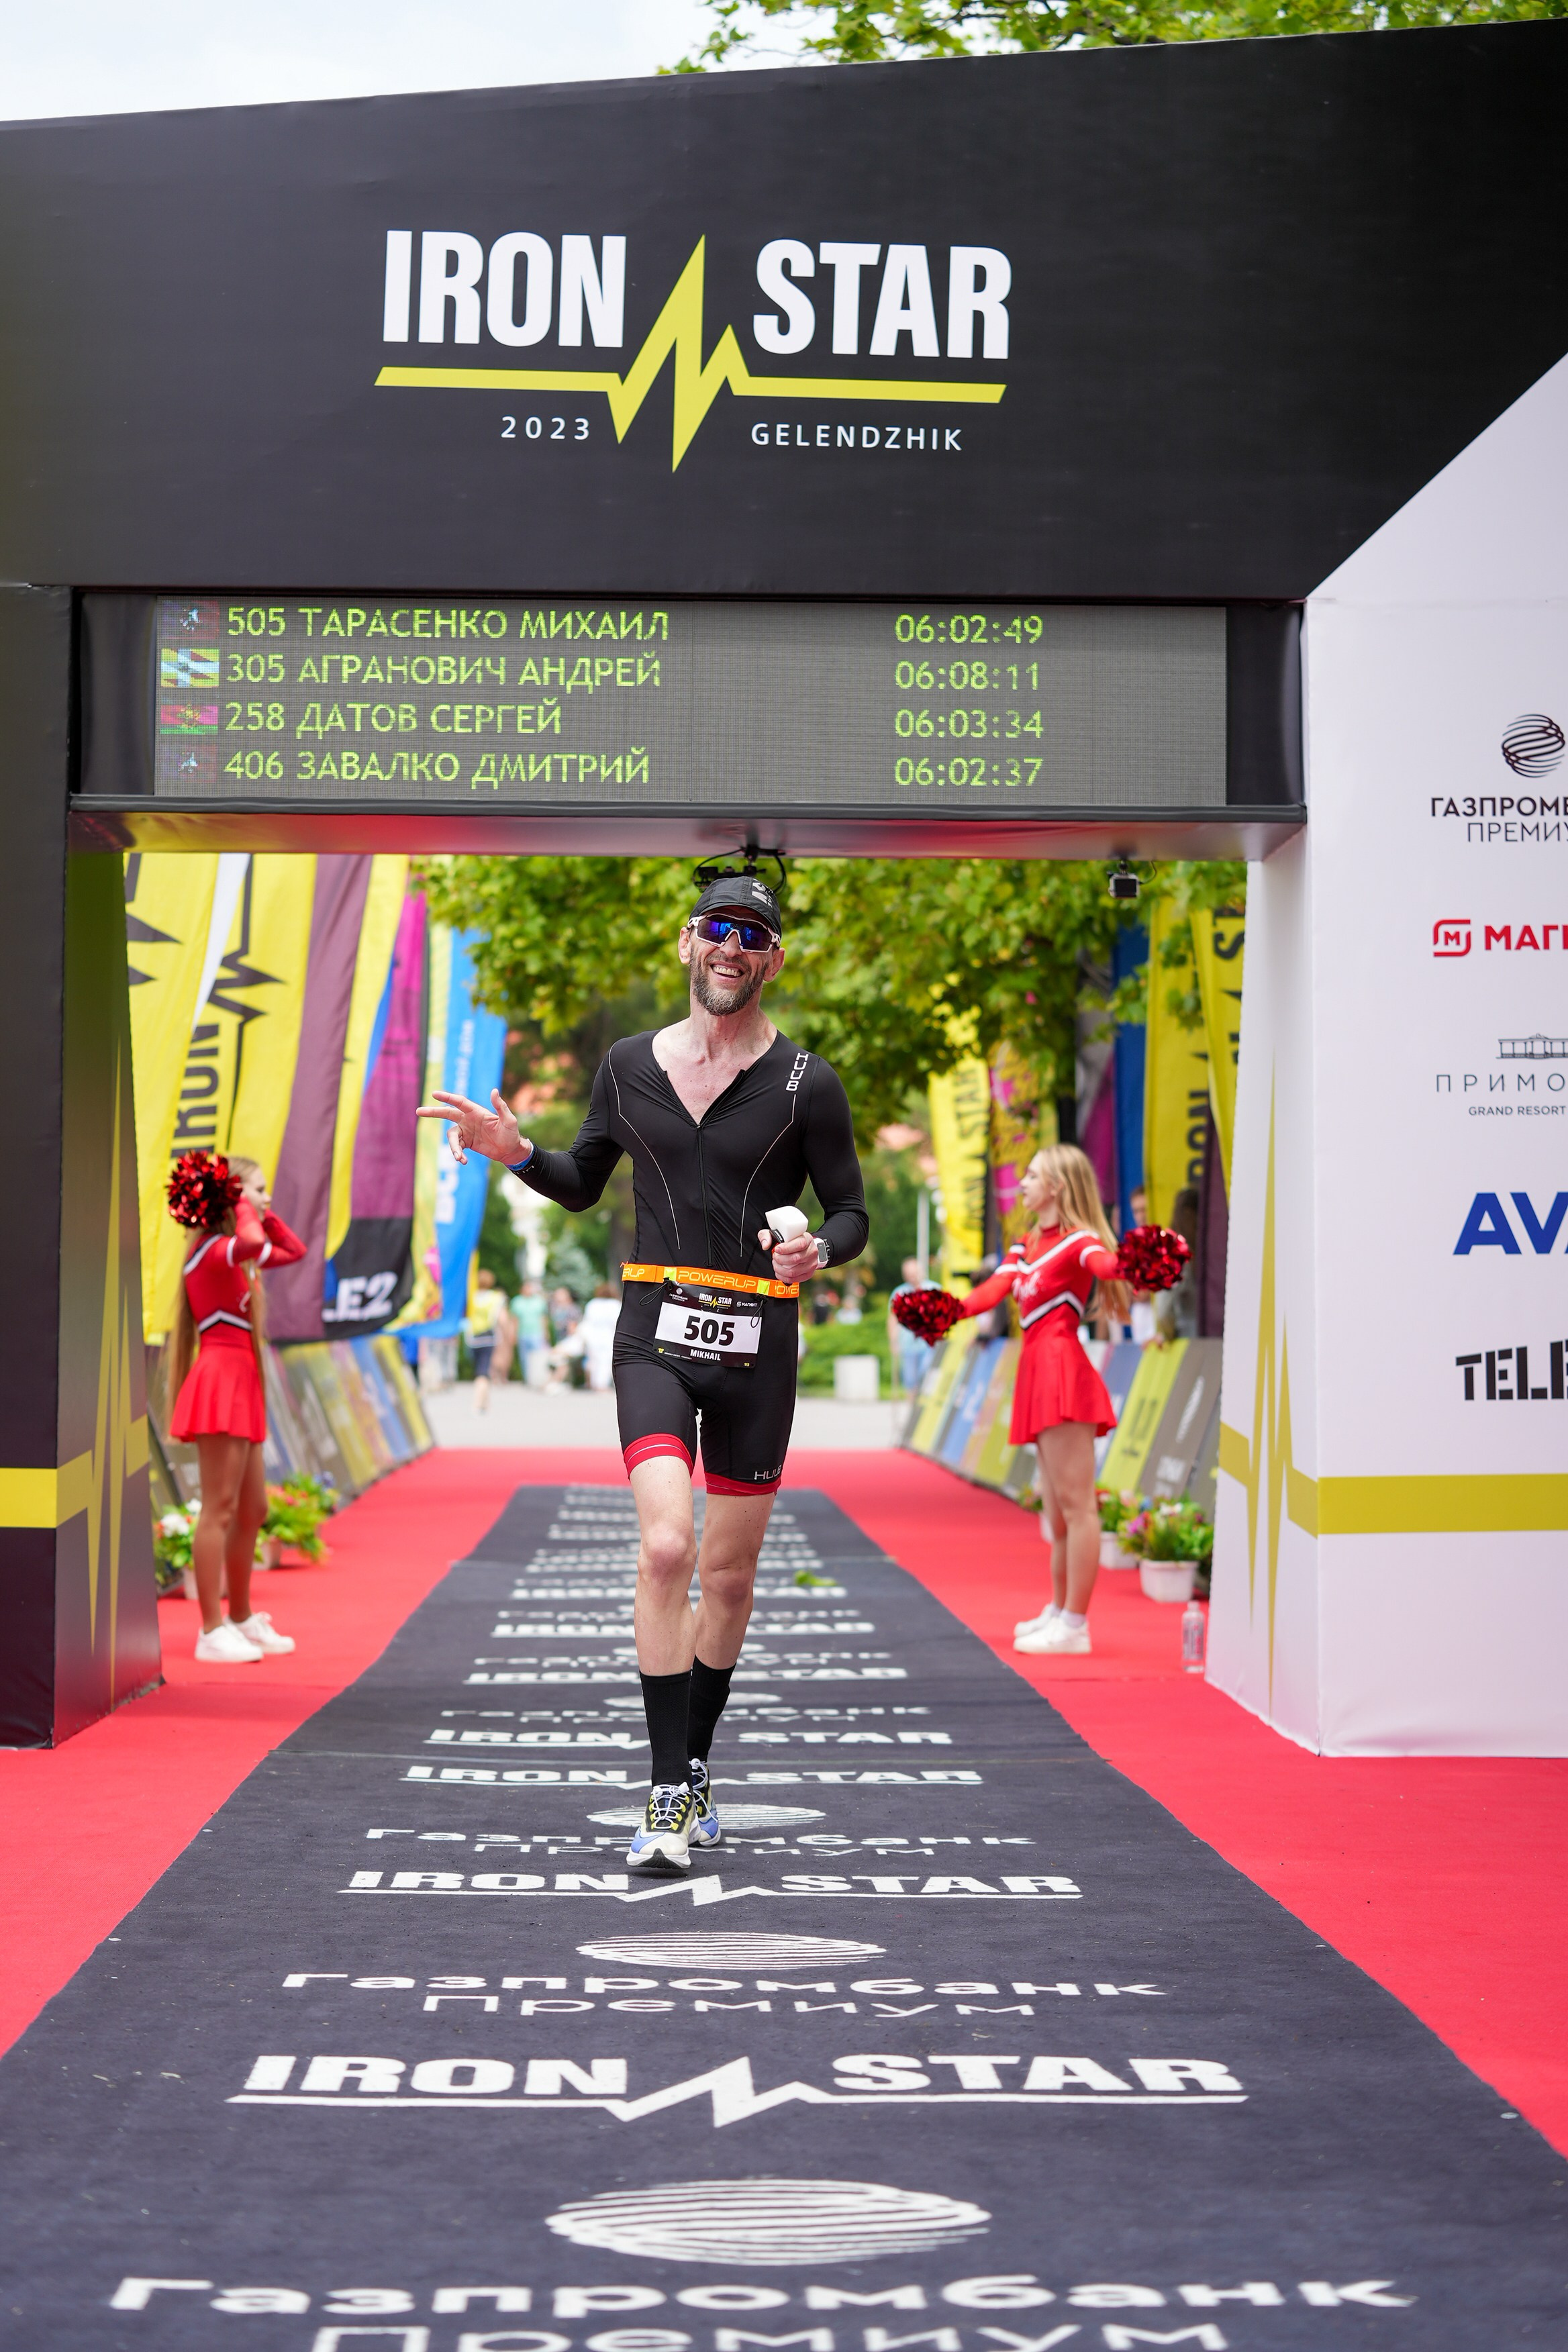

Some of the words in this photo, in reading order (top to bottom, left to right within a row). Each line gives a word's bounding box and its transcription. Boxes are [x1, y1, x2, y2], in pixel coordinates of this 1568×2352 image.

[383, 230, 626, 348] IRON
[753, 239, 1012, 360] STAR
[501, 416, 589, 440] 2023
[751, 423, 962, 451] GELENDZHIK
[228, 606, 286, 636] 505
[298, 607, 507, 639] ТАРАСЕНКО
[520, 609, 669, 641] МИХАИЛ
[894, 614, 1044, 643] 06:02:49
[227, 652, 285, 683] 305
[297, 654, 507, 685] АГРАНОВИЧ
[518, 650, 662, 693] АНДРЕЙ
[894, 660, 1040, 690] 06:08:11
[225, 701, 285, 732] 258
[295, 701, 418, 739] ДАТОВ
[430, 697, 562, 734] СЕРГЕЙ
[894, 709, 1044, 738] 06:03:34
[224, 750, 285, 780] 406
[297, 750, 460, 781] ЗАВАЛКО
[471, 746, 650, 789] ДМИТРИЙ
[894, 756, 1044, 786] 06:02:37
[1431, 796, 1568, 817] ГАЗПРОМ
[785, 1052, 810, 1091] HUUB
[1436, 1073, 1566, 1093] ПРИМО
[1468, 1106, 1514, 1116] GRAND
[1516, 1105, 1566, 1116] RESORT
[1453, 1191, 1568, 1255] AV
[678, 1270, 756, 1289] POWERUP
[699, 1293, 713, 1302] IRON
[718, 1296, 732, 1305] STAR
[683, 1315, 736, 1346] 505
[690, 1349, 722, 1361] MIKHAIL
[430, 1729, 631, 1743] IRON
[738, 1732, 952, 1745] STAR
[407, 1765, 628, 1783] IRON
[746, 1770, 981, 1782] STAR
[366, 1828, 1036, 1845] Газпрмбанк
[348, 1871, 629, 1891] IRON
[781, 1875, 1081, 1894] STAR
[282, 1973, 1168, 1994] Газпромбанк
[423, 1995, 1036, 2018] Премиум
[243, 2055, 628, 2095] IRON
[832, 2054, 1243, 2091] STAR
[109, 2275, 1419, 2319] Газпромбанк
[311, 2324, 1228, 2352] Премиум
